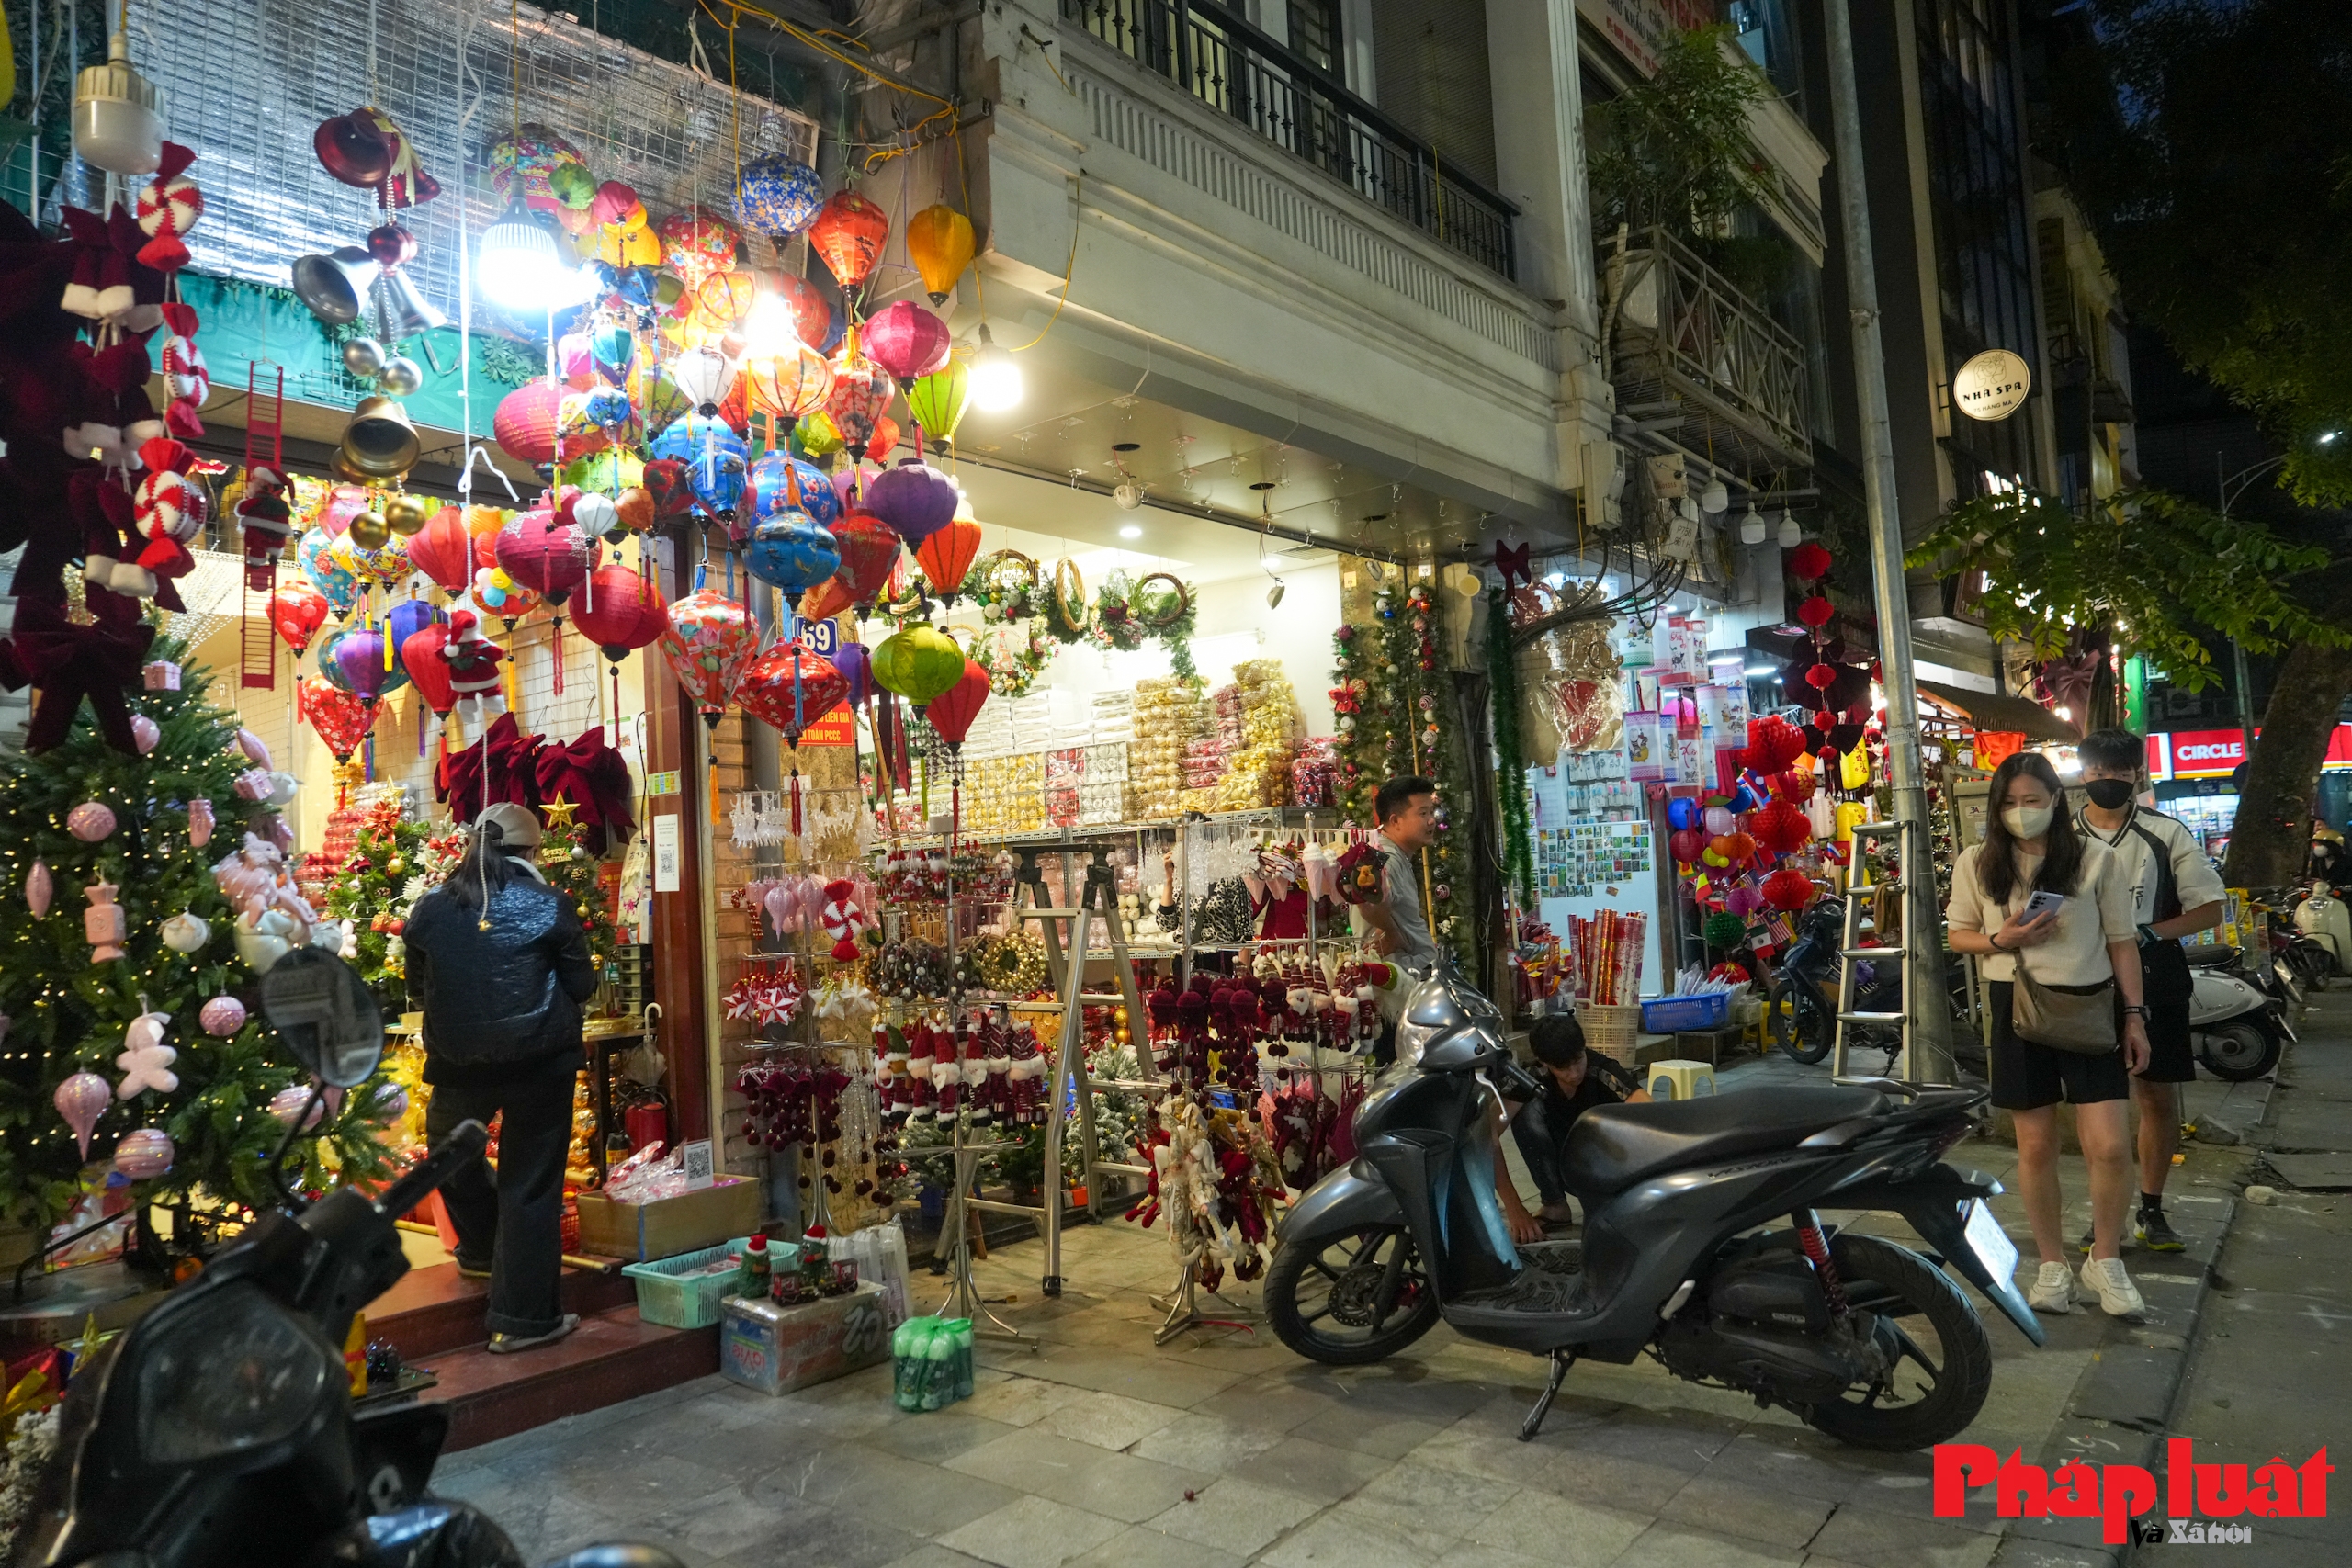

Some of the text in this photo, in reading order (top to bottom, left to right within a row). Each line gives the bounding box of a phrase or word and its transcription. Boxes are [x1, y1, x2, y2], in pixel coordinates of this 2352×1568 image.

[1962, 381, 2022, 402] NHÀ SPA
[1982, 402, 2001, 412] HÀNG
[801, 623, 831, 652] 69
[839, 712, 850, 723] GIA
[808, 728, 824, 741] TOÀN
[824, 730, 841, 741] PCCC
[2177, 742, 2243, 761] CIRCLE
